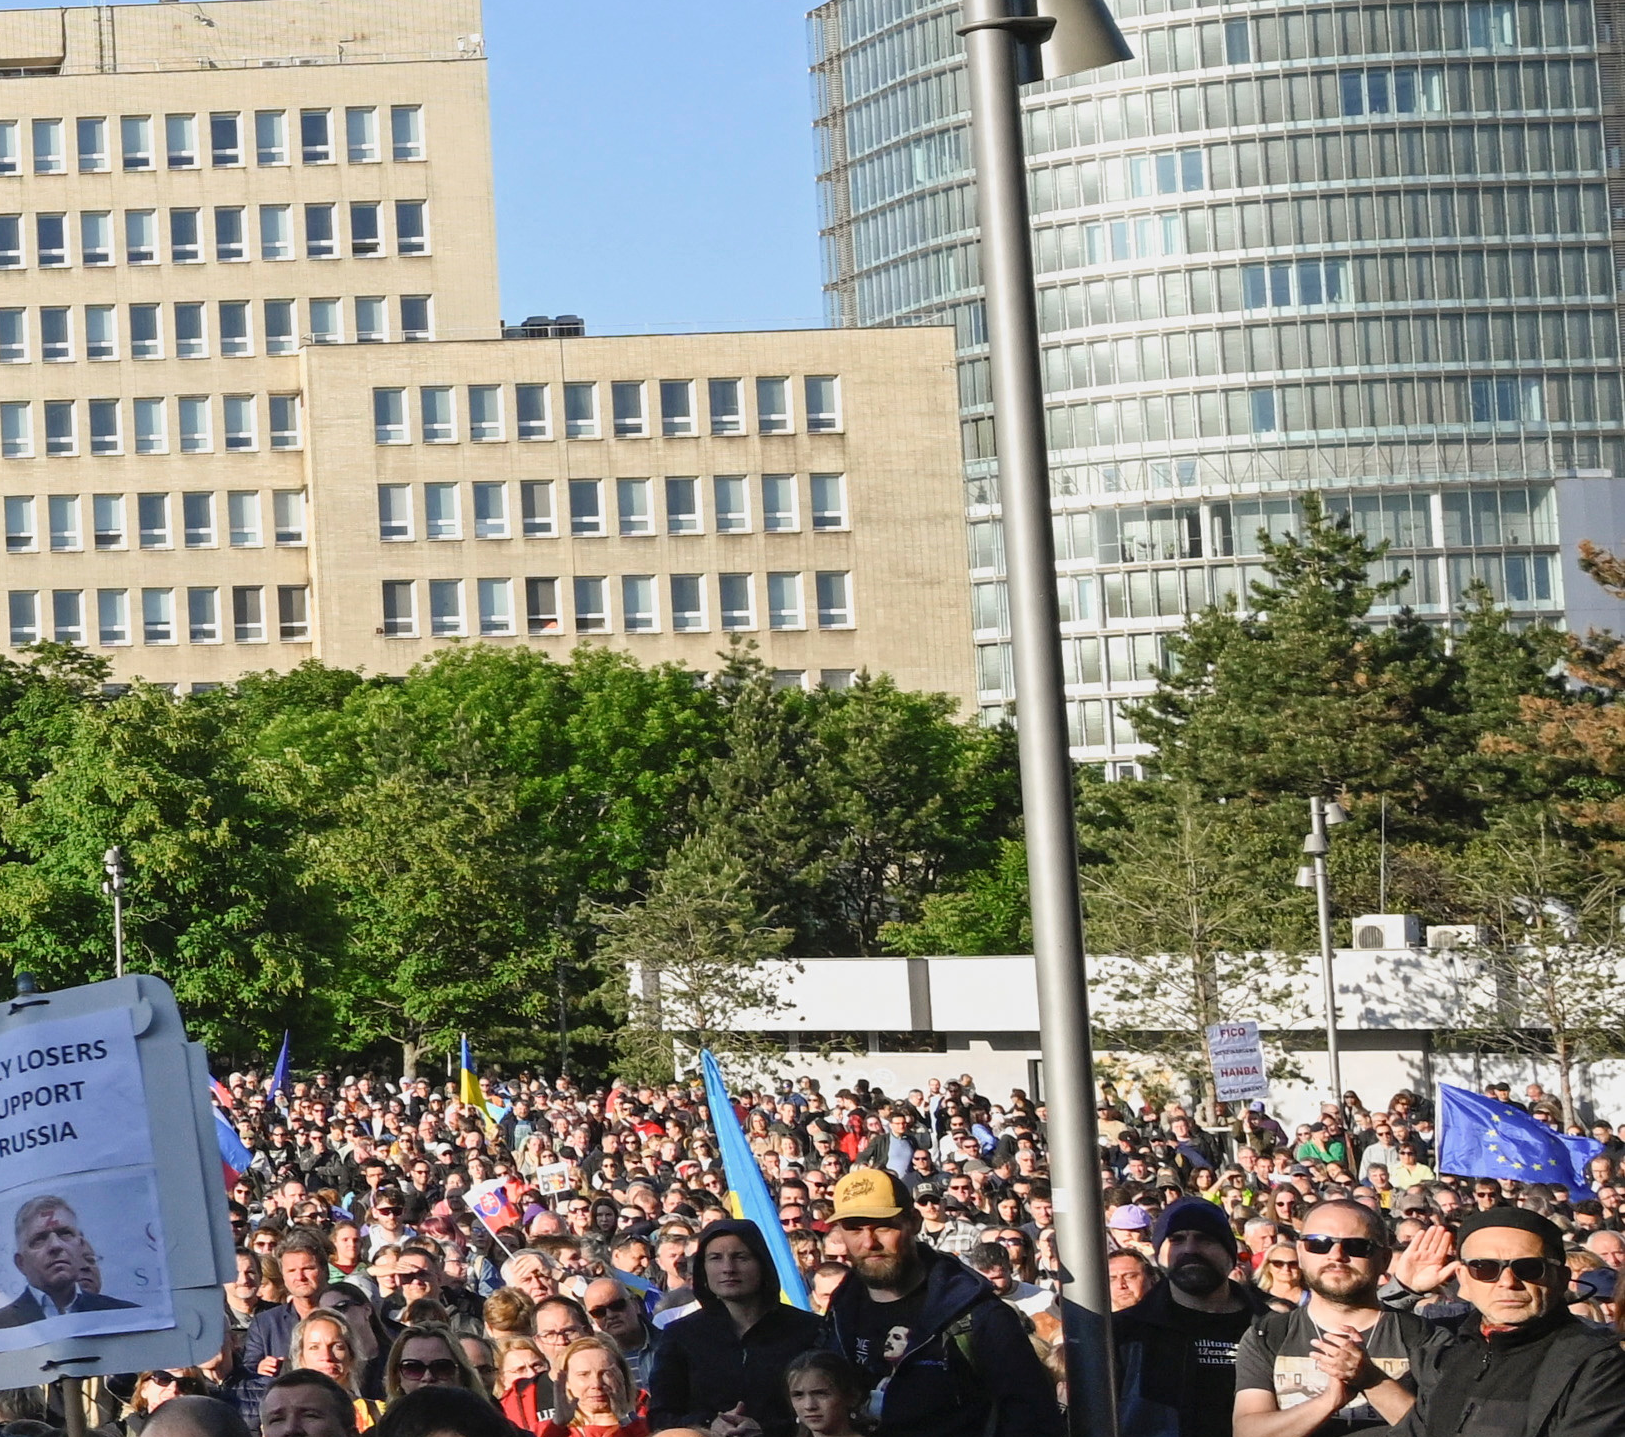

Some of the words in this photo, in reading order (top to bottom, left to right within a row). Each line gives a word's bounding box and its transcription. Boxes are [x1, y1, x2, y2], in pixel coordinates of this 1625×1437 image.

[1220, 1027, 1246, 1038] FICO
[18, 1040, 108, 1073] LOSERS
[1220, 1066, 1259, 1077] HANBA
